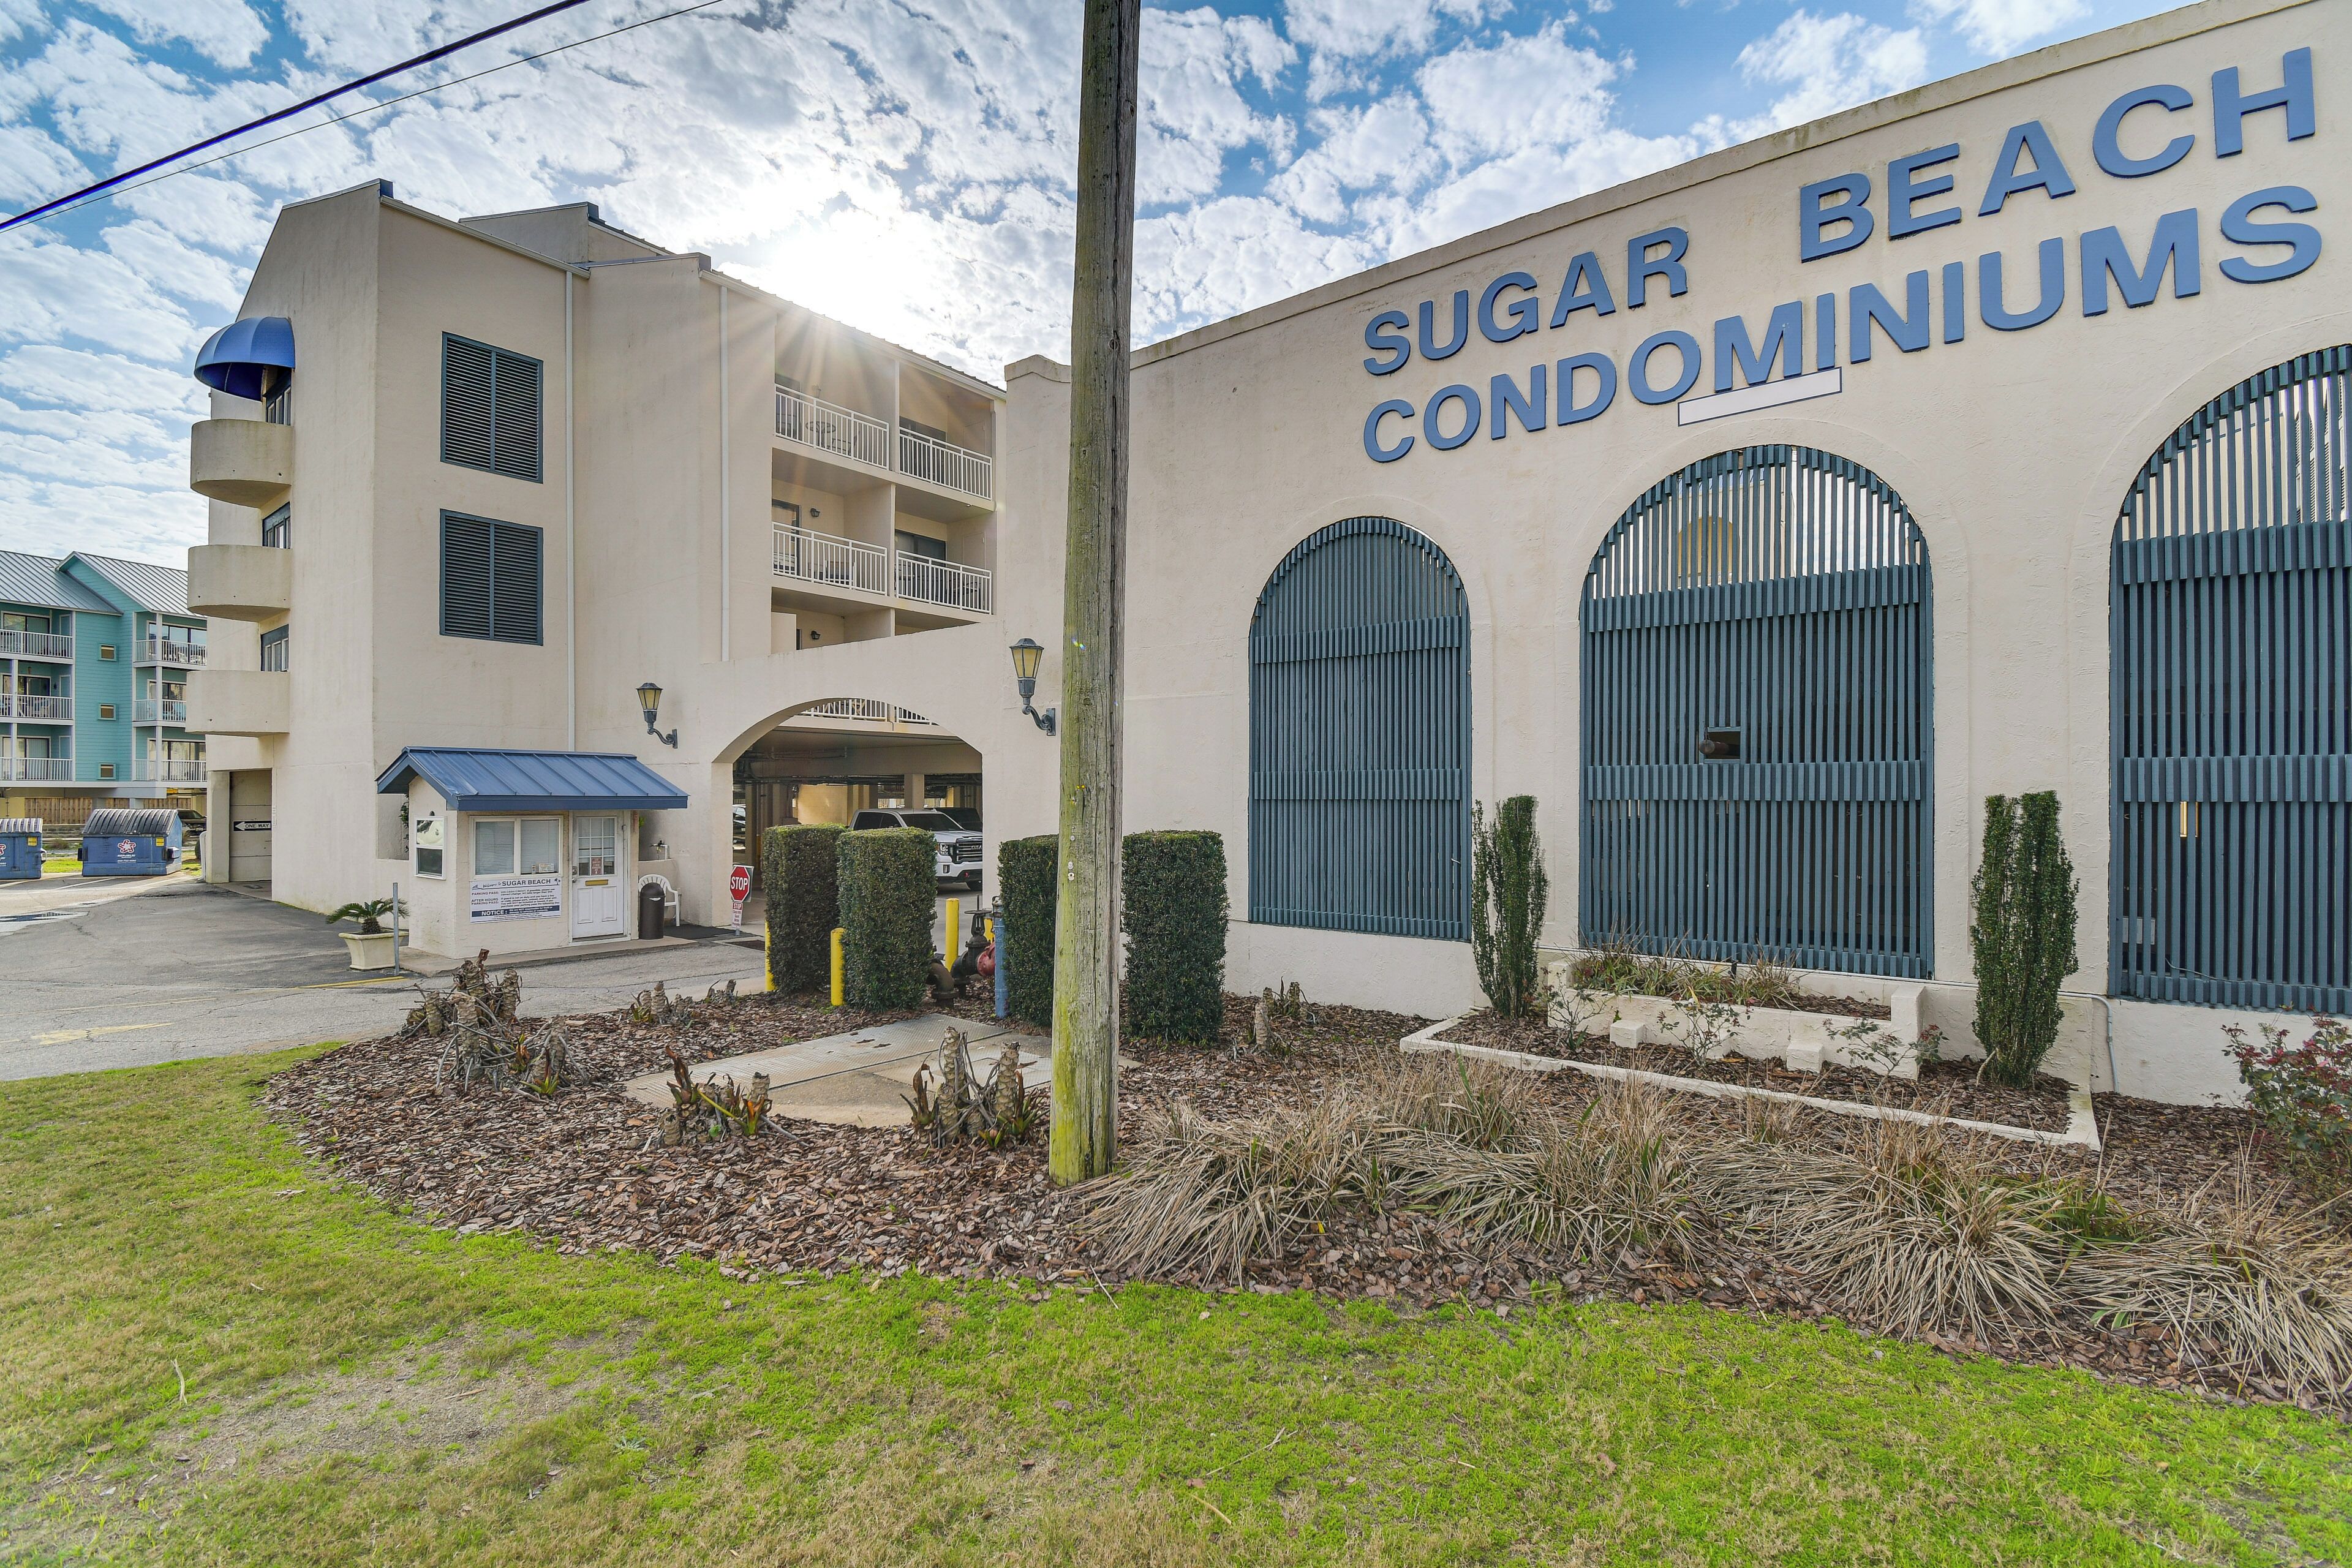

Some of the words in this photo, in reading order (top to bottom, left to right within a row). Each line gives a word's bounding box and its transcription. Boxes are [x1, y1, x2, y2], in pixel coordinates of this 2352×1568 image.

[1363, 227, 1689, 376] SUGAR
[1800, 46, 2316, 263] BEACH
[1363, 185, 2322, 464] CONDOMINIUMS
[731, 876, 748, 890] STOP
